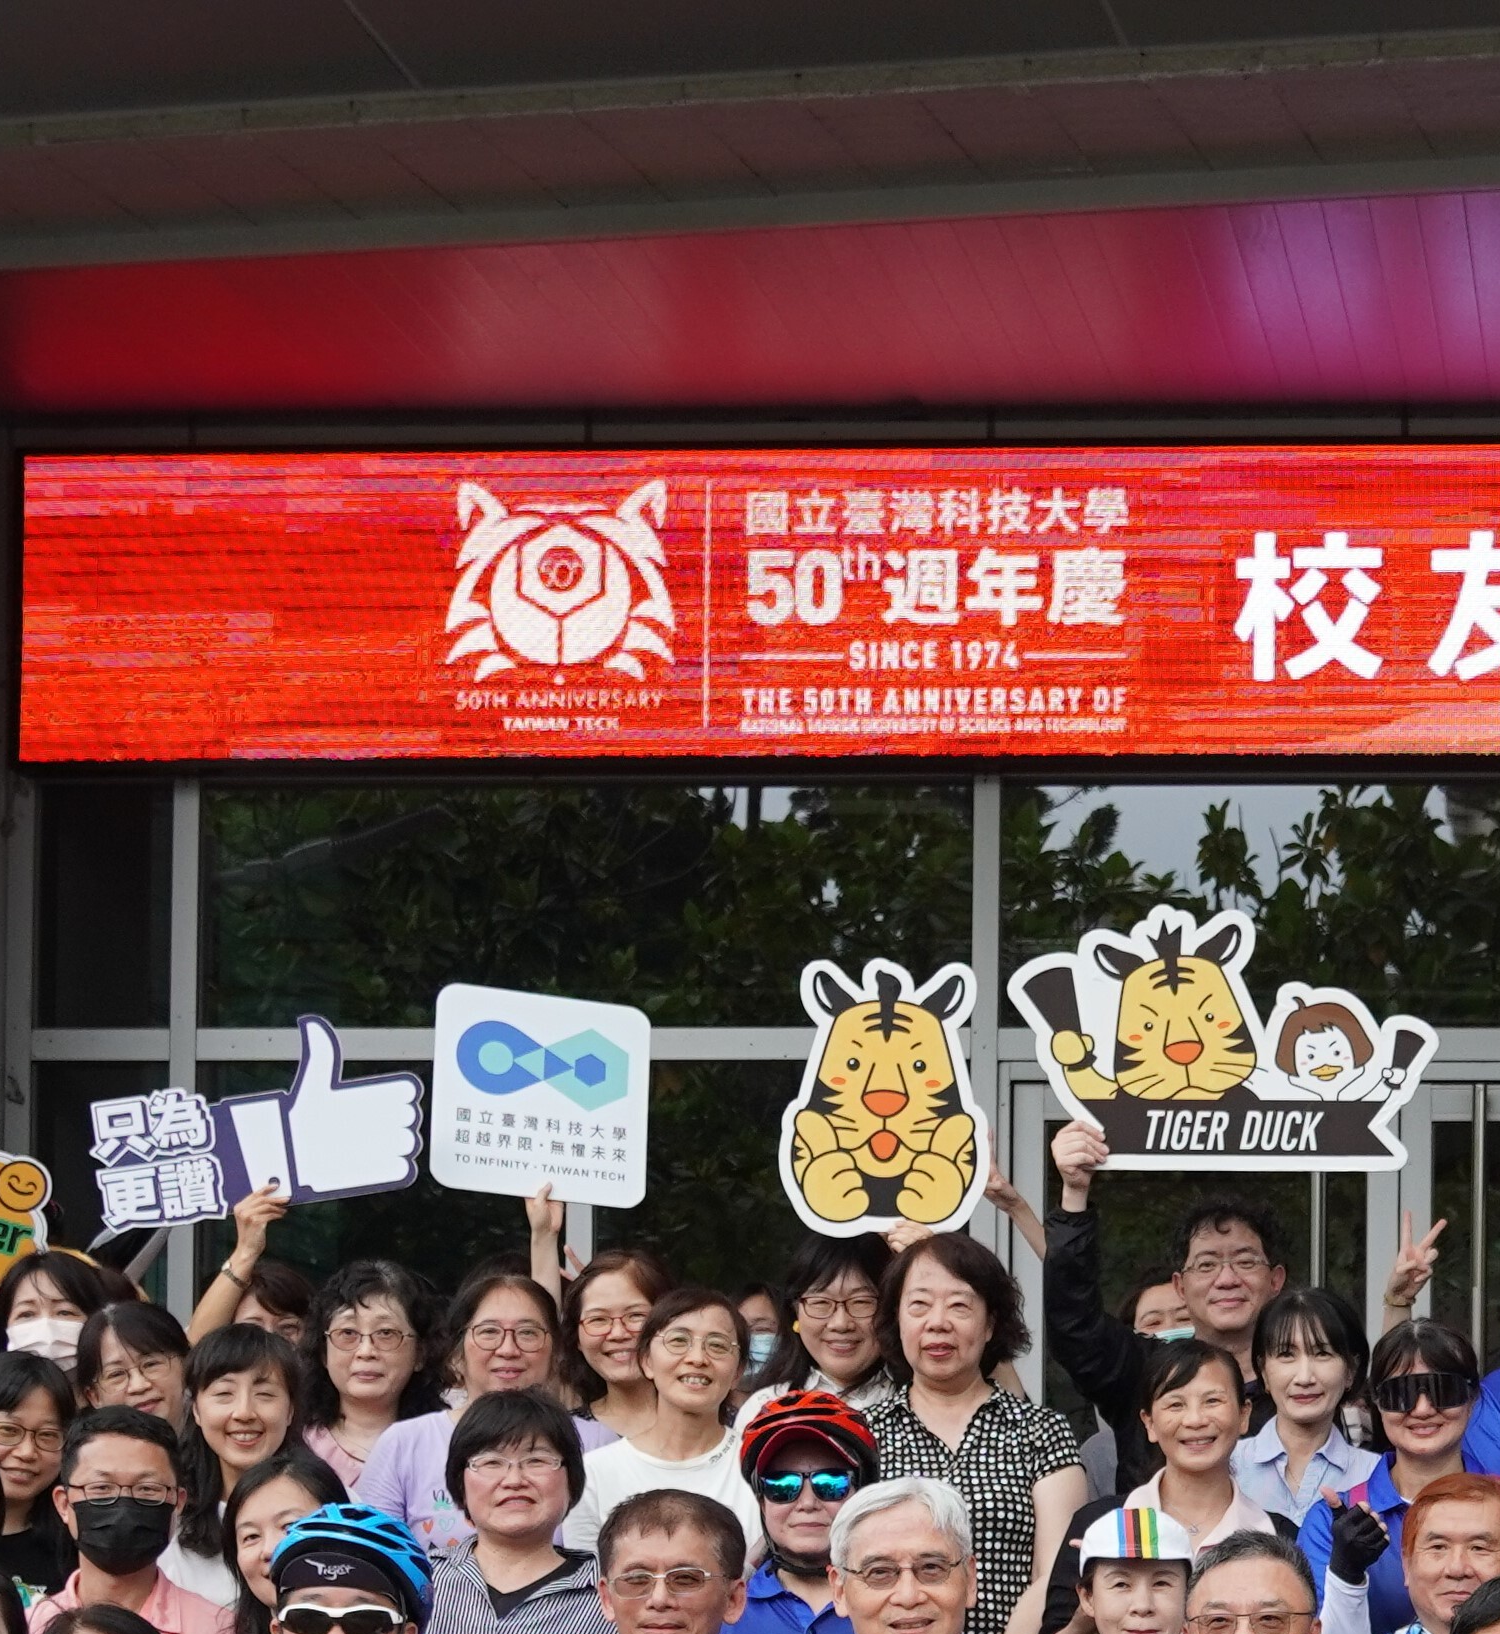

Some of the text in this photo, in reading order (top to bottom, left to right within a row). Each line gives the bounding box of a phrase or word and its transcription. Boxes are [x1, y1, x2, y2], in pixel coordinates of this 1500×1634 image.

[745, 487, 1131, 537] 國立臺灣科技大學
[849, 641, 1019, 671] SINCE 1974
[454, 688, 664, 711] 50TH ANNIVERSARY
[741, 687, 1127, 715] THE 50TH ANNIVERSARY OF
[94, 1093, 209, 1159] 只為
[456, 1107, 628, 1142] 國立臺灣科技大學
[1145, 1109, 1325, 1152] TIGER DUCK
[455, 1153, 626, 1182] TO INFINITY TAIWAN TECH
[102, 1158, 222, 1224] 更讚
